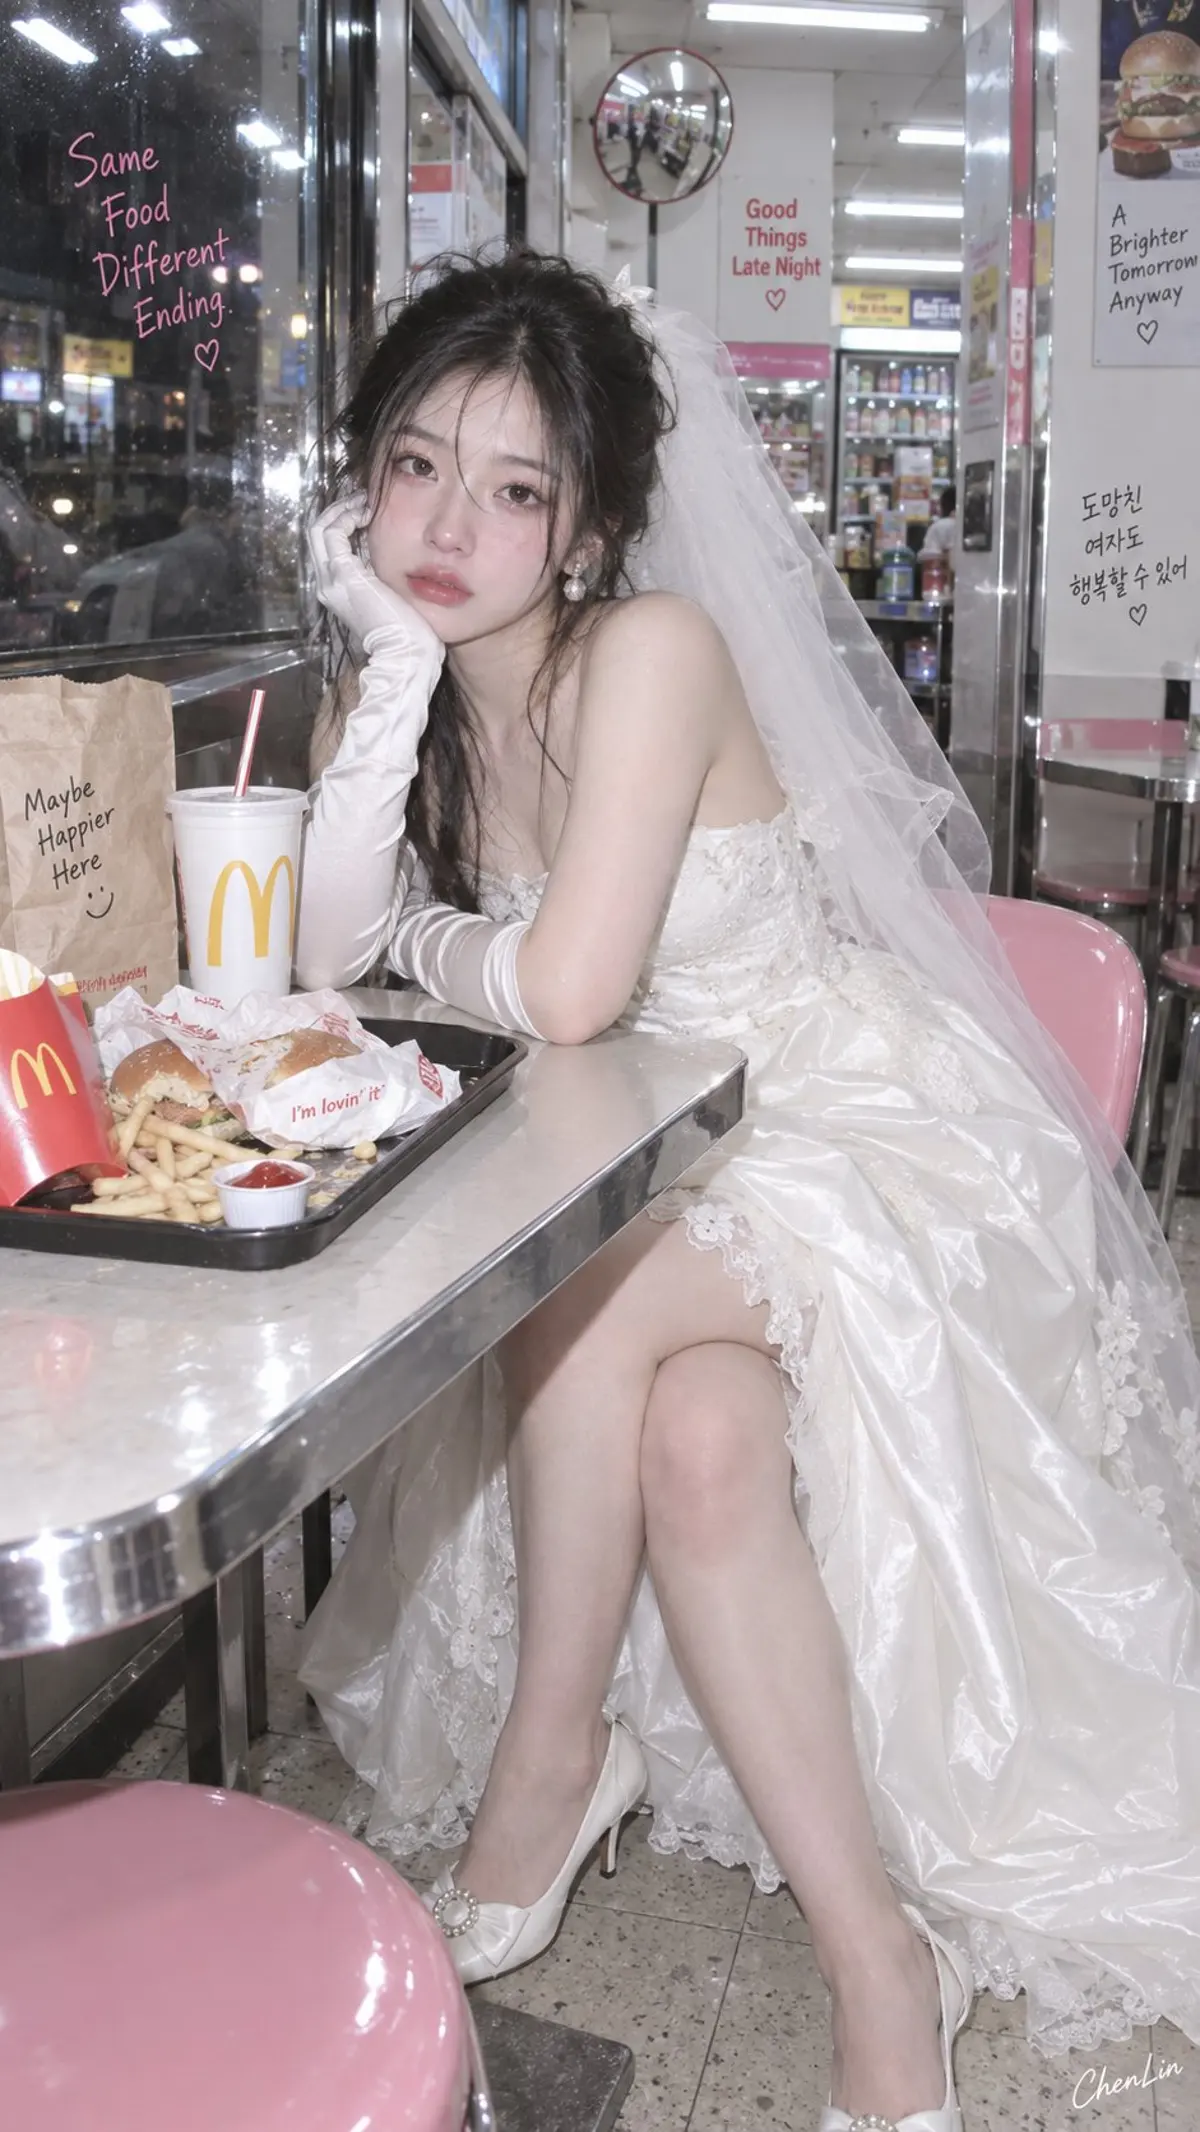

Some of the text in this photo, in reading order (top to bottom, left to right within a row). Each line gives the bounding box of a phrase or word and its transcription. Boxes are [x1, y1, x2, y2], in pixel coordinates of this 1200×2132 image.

[68, 131, 160, 188] Same
[101, 183, 171, 237] Food
[746, 197, 798, 219] Good
[1111, 203, 1127, 228] A
[745, 226, 808, 252] Things
[1109, 226, 1189, 259] Brighter
[92, 227, 230, 297] Different
[732, 255, 821, 281] Late Night
[1107, 254, 1199, 285] Tomorrow
[1108, 285, 1184, 316] Anyway
[1081, 484, 1143, 522] 도망친
[1085, 525, 1144, 557] 여자도
[1069, 554, 1188, 606] 행복할 수 있어
[24, 775, 96, 821] Maybe
[37, 807, 116, 857] Happier
[52, 854, 103, 890] Here
[291, 1105, 317, 1123] I'm
[321, 1089, 364, 1115] lovin'
